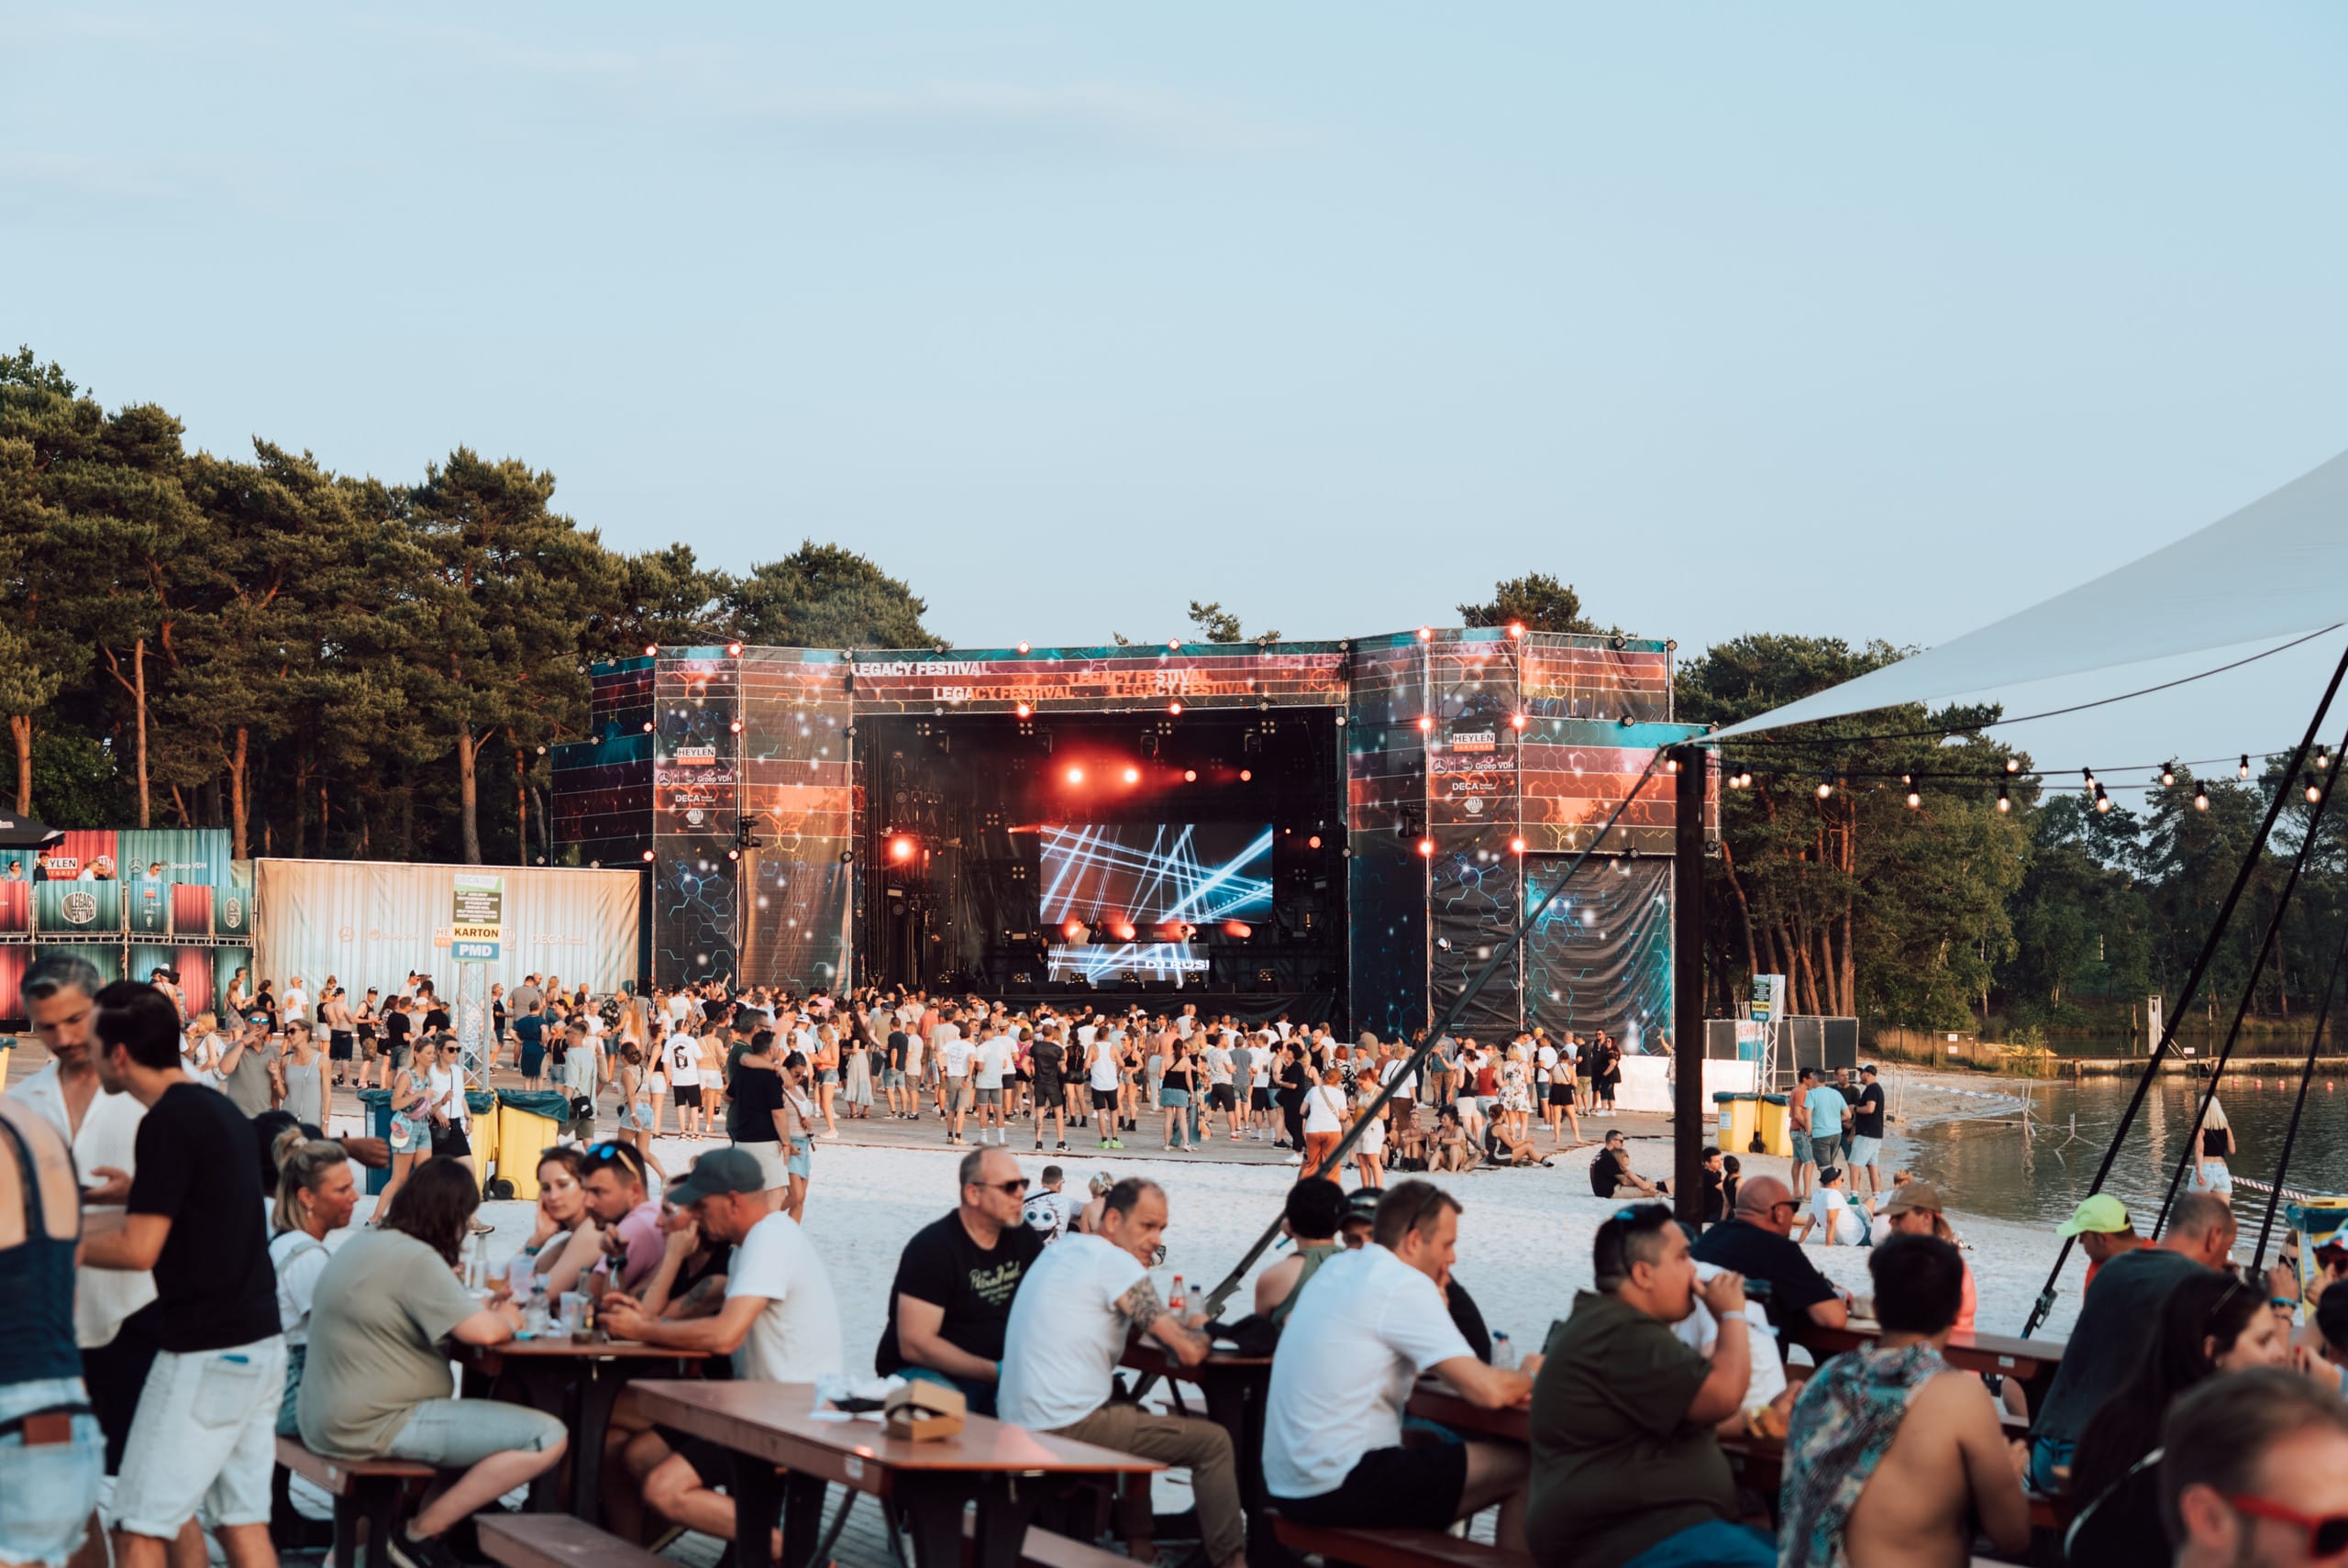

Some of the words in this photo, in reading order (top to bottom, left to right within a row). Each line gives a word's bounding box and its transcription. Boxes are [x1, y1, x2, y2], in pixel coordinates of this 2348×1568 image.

[851, 662, 913, 676] LEGACY
[917, 661, 991, 675] FESTIVAL
[1070, 670, 1132, 685] LEGACY
[1135, 669, 1211, 683] FESTIVAL
[933, 687, 996, 701] LEGACY
[1000, 685, 1074, 700] FESTIVAL
[1113, 684, 1174, 697] LEGACY
[1180, 682, 1255, 695] FESTIVAL
[678, 748, 714, 756] HEYLEN
[1475, 763, 1497, 772] Groep
[1452, 782, 1479, 790] DECA
[675, 794, 700, 802] DECA
[72, 892, 95, 908] LEGACY
[454, 927, 499, 937] KARTON
[531, 933, 565, 944] DECA
[459, 944, 493, 956] PMD
[1146, 960, 1166, 969] DJ
[673, 1044, 688, 1070] 6
